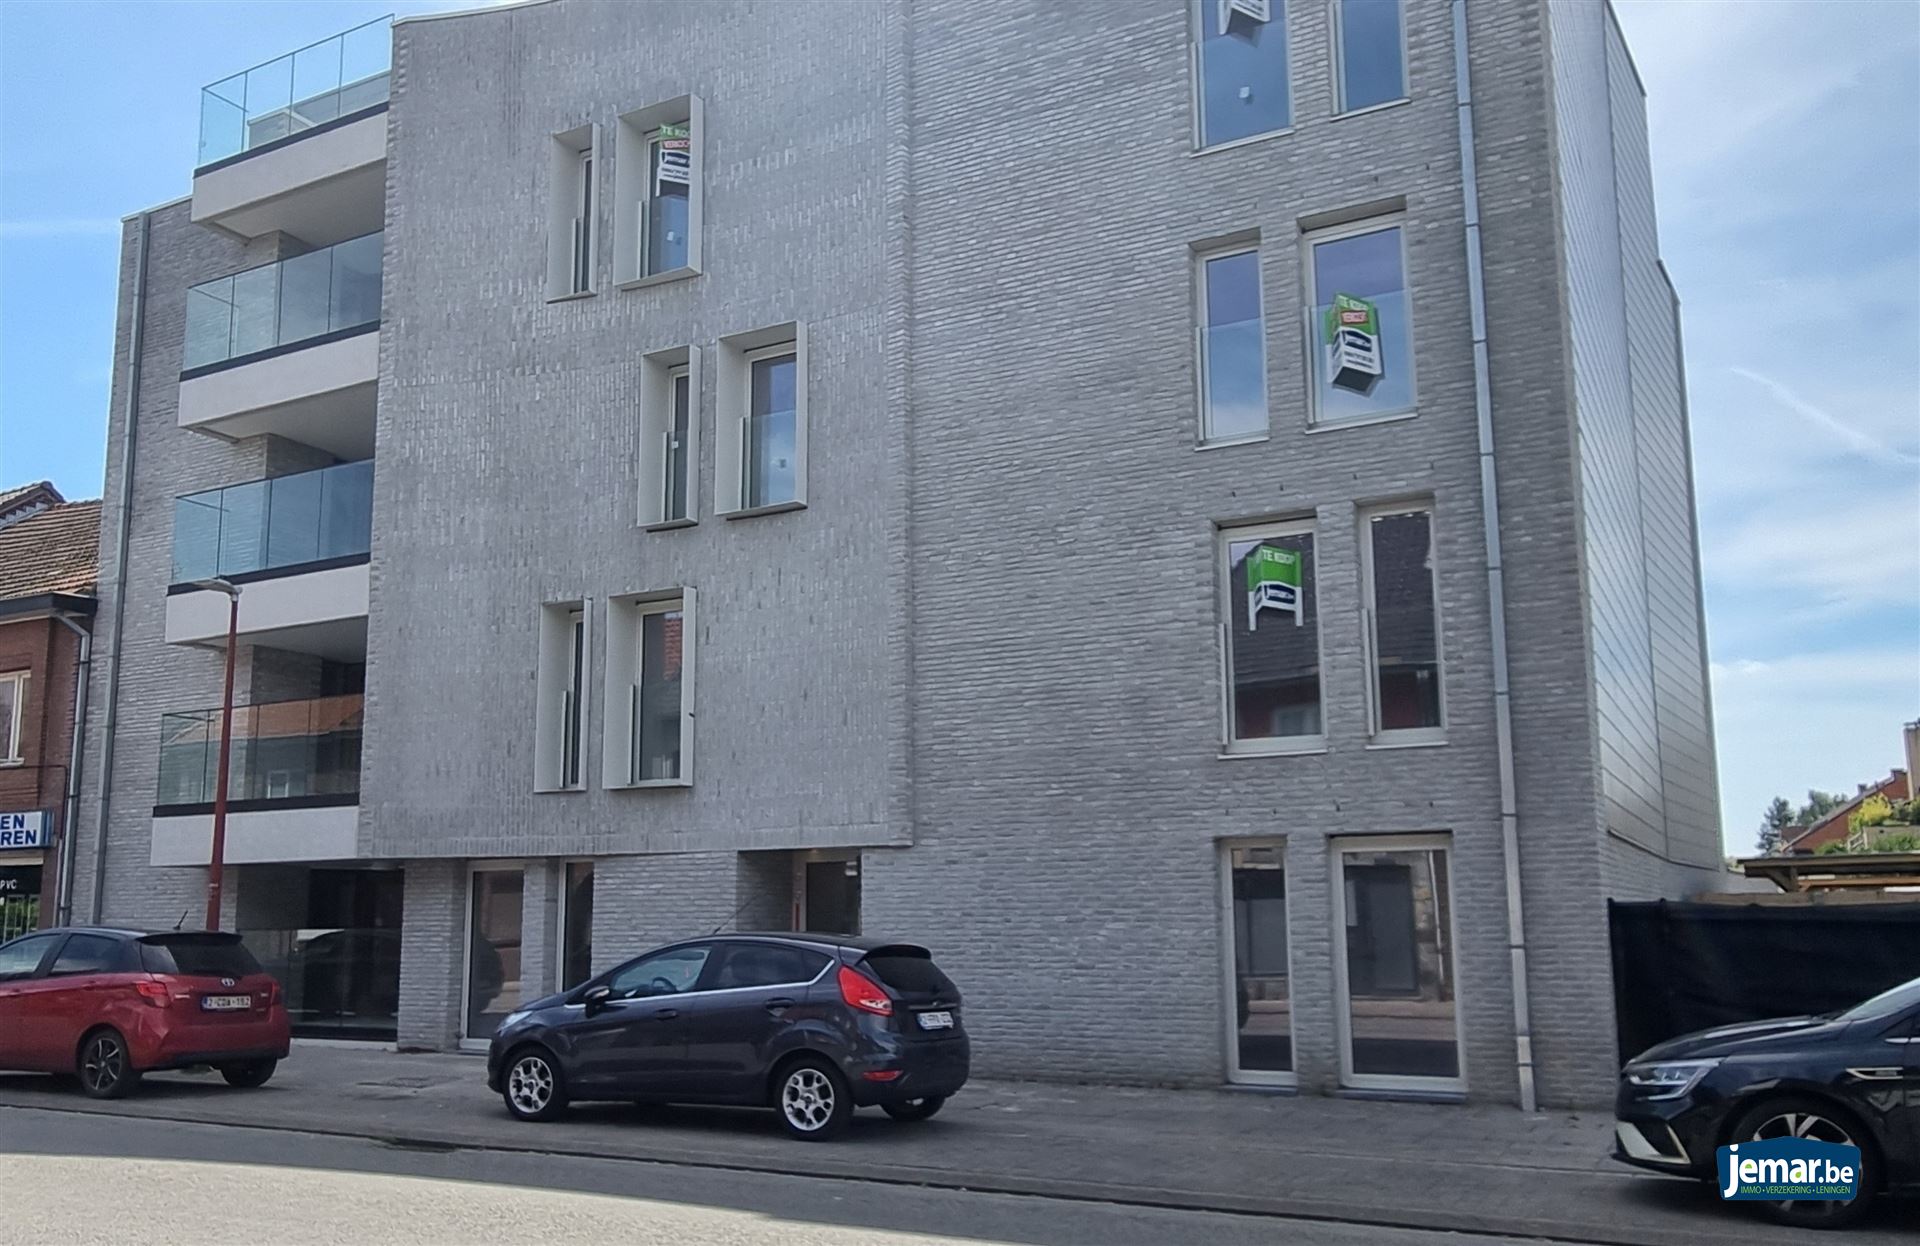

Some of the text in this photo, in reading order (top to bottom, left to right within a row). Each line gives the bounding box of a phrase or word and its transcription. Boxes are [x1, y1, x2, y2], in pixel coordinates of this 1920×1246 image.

[1262, 548, 1273, 561] TE
[0, 814, 25, 830] EN
[0, 829, 37, 846] REN
[0, 879, 17, 890] PVC
